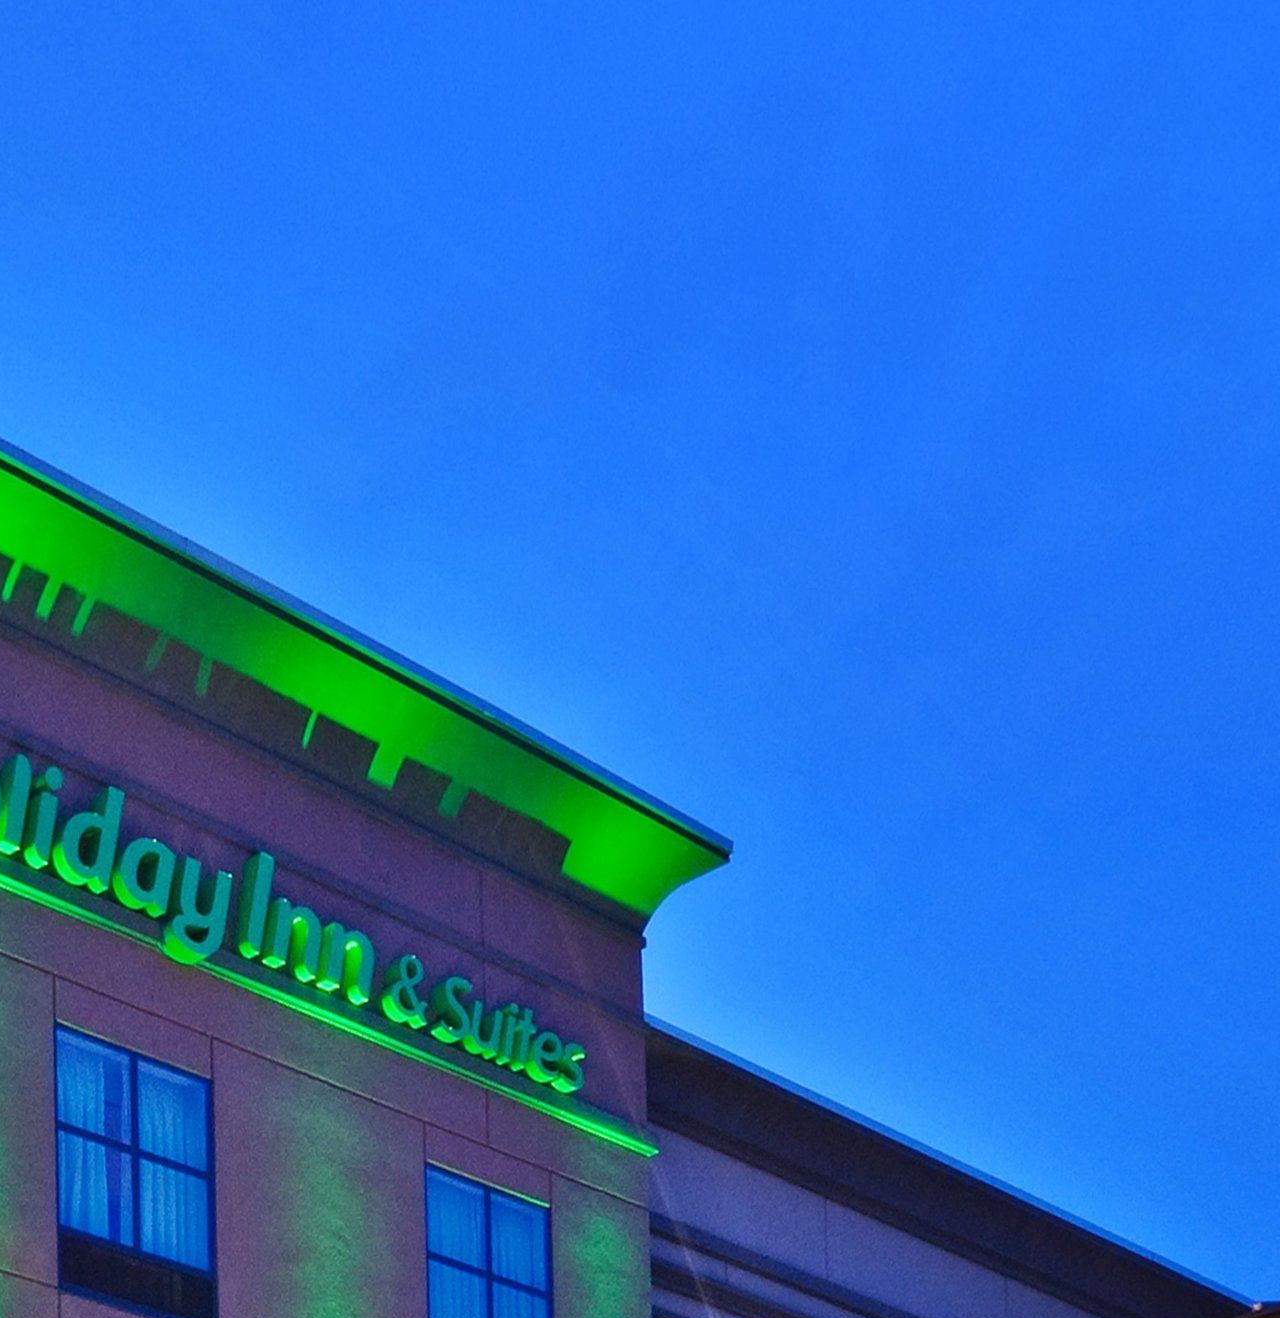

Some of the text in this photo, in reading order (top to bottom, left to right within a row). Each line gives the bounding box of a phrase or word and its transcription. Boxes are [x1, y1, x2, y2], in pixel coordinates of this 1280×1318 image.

[238, 851, 375, 1006] Inn
[382, 954, 427, 1029] &
[430, 976, 586, 1093] Suites
